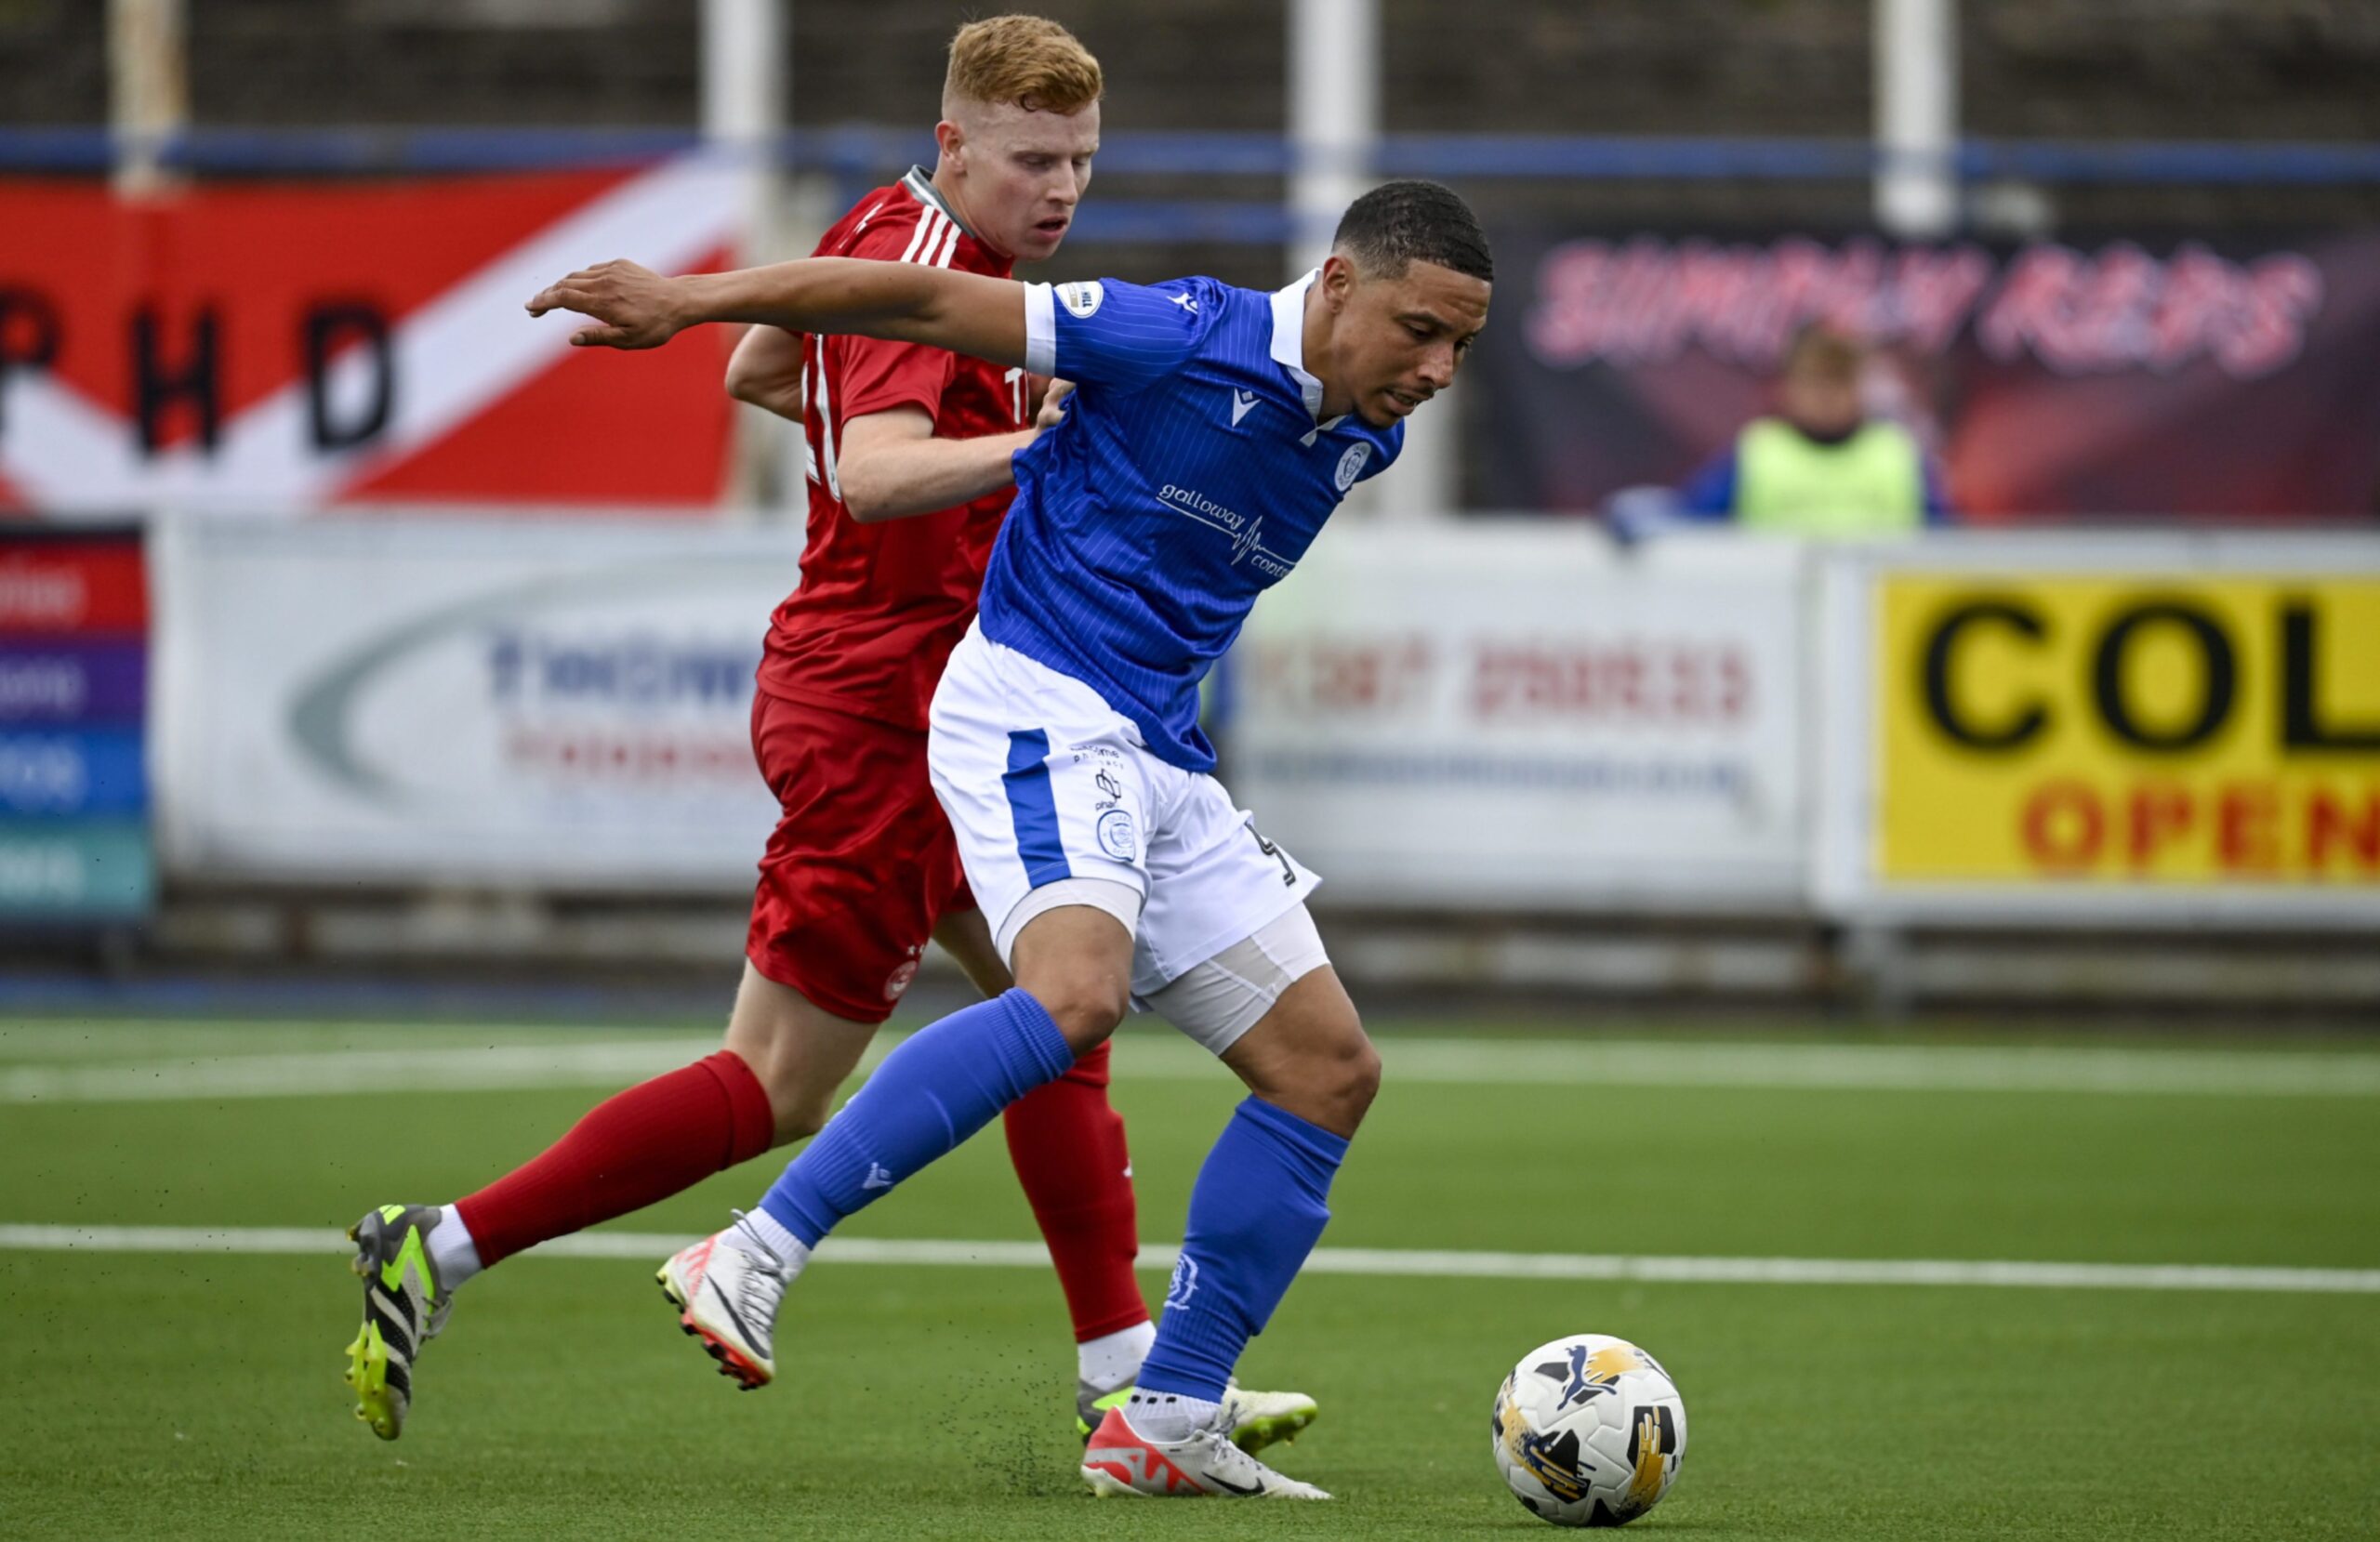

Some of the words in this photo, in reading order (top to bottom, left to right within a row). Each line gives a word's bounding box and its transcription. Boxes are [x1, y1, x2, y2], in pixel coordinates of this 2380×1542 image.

[1158, 483, 1246, 530] galloway
[1915, 588, 2380, 758] COL
[2019, 781, 2380, 879] OPEN
